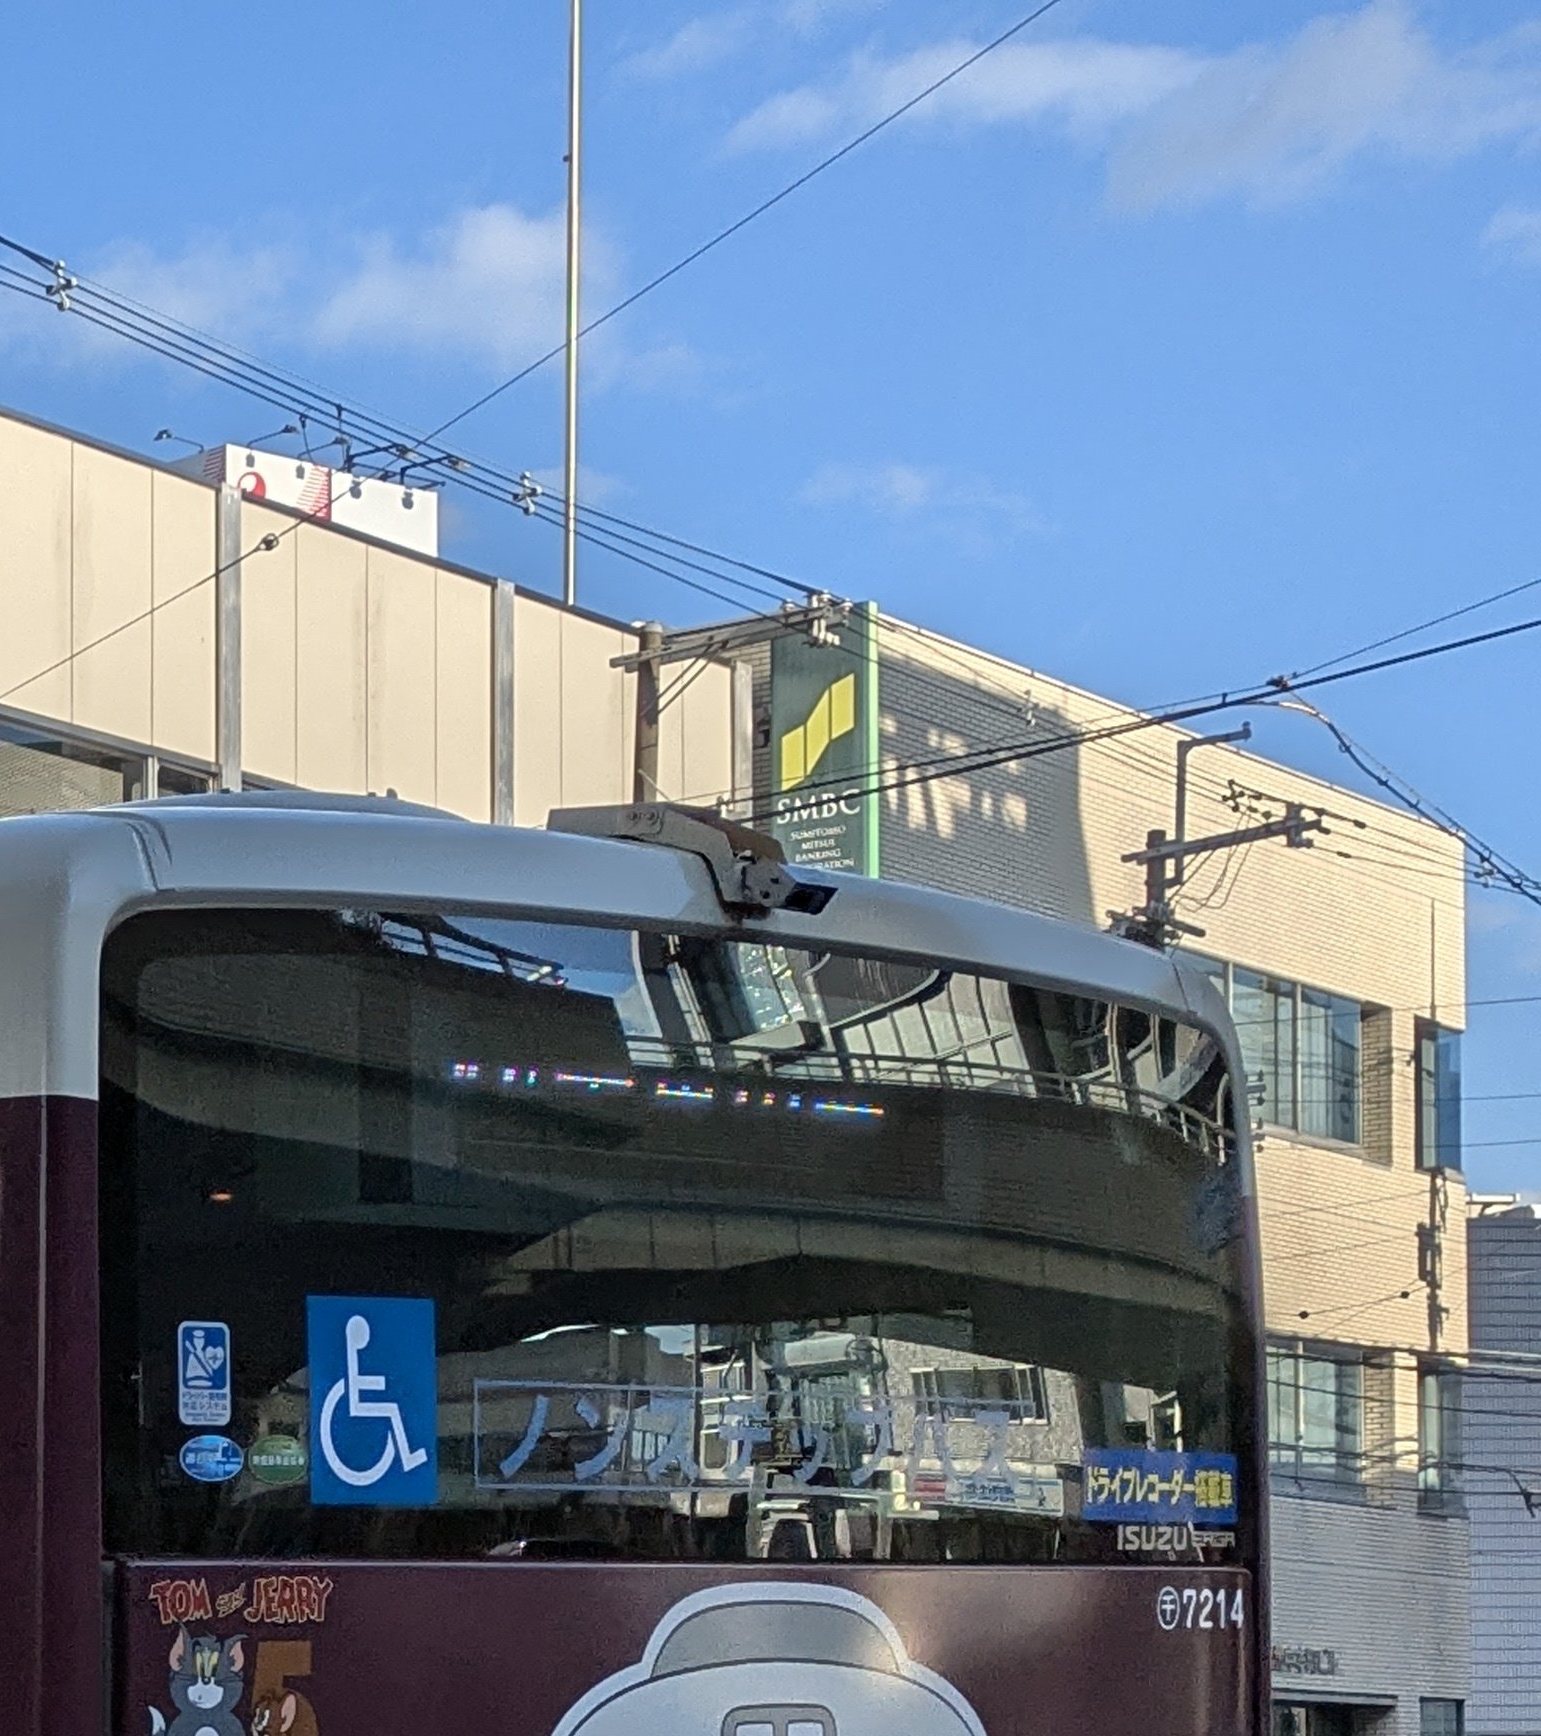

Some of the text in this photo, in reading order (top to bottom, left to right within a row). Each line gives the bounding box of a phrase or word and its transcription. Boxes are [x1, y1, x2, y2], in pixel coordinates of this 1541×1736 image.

[777, 788, 861, 824] SMBC
[1118, 1526, 1187, 1551] ISUZU
[149, 1578, 212, 1625] TOM
[244, 1576, 334, 1624] JERRY
[1183, 1588, 1245, 1630] 7214
